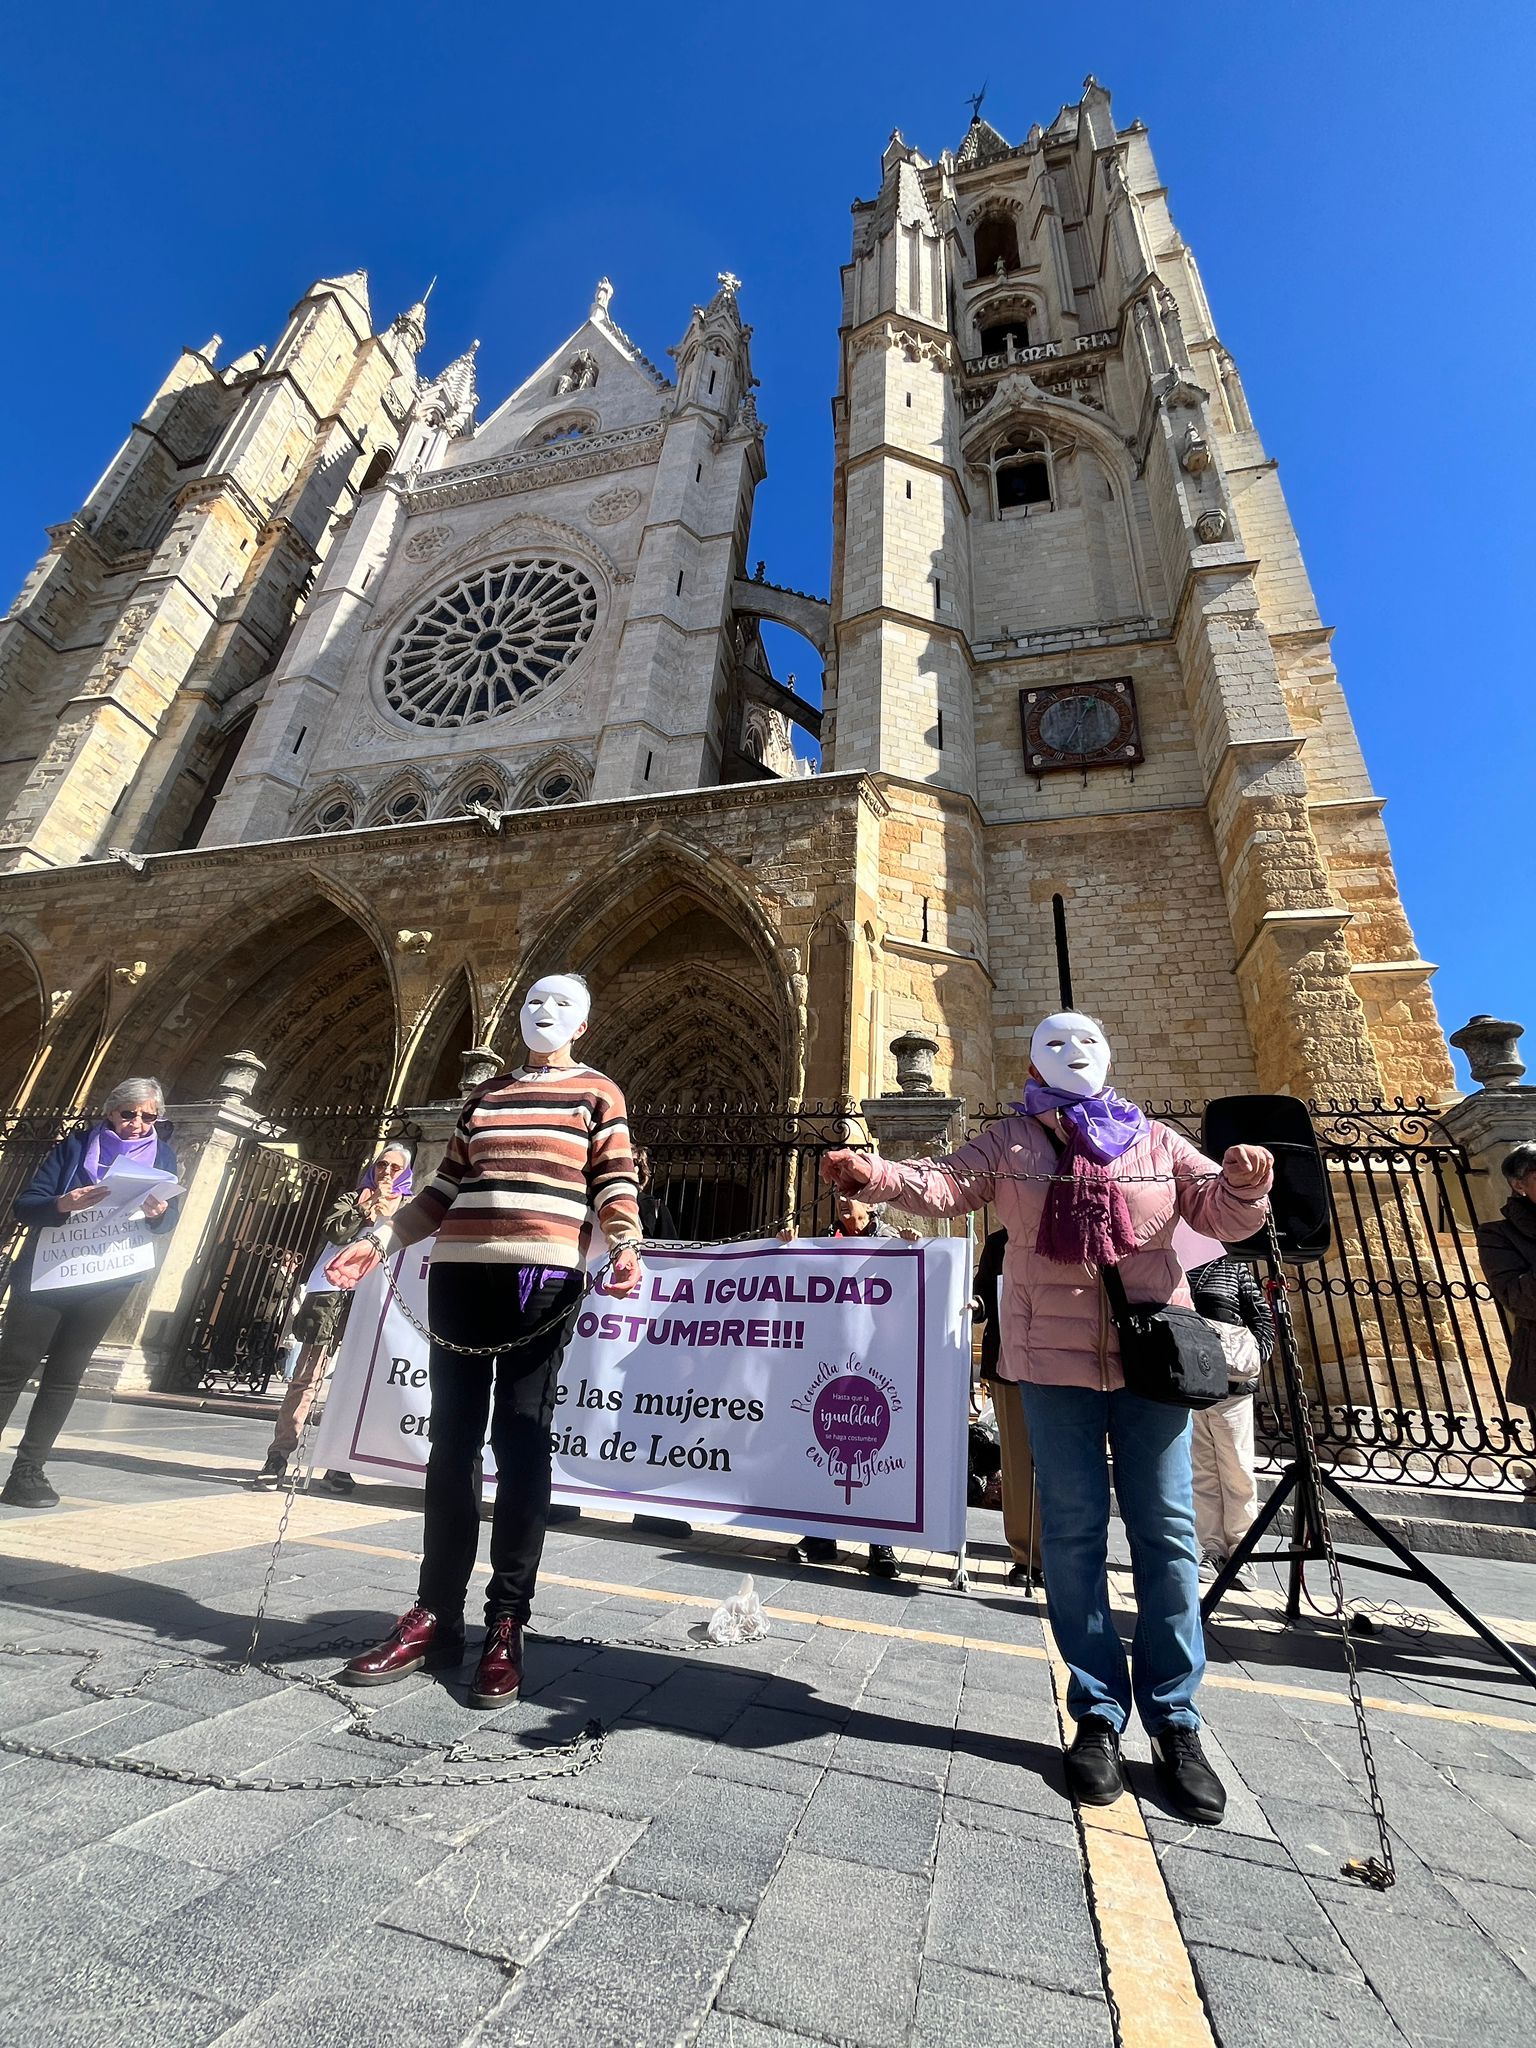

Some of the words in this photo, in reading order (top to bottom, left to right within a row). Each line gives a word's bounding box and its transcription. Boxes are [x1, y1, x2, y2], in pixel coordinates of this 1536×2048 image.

[51, 1231, 66, 1244] LA
[70, 1224, 120, 1241] IGLESIA
[121, 1220, 140, 1232] SEA
[42, 1249, 68, 1263] UNA
[71, 1235, 145, 1259] COMUNIDAD
[60, 1264, 78, 1278] DE
[82, 1253, 136, 1275] IGUALES
[651, 1276, 695, 1304] LA
[703, 1274, 894, 1306] IGUALDAD
[576, 1311, 805, 1350] OSTUMBRE!!!
[790, 1361, 840, 1413] Revuelta
[846, 1351, 862, 1373] de
[868, 1367, 904, 1414] mujeres
[575, 1378, 624, 1412] las
[633, 1388, 765, 1424] mujeres
[832, 1393, 850, 1401] Hasta
[851, 1395, 863, 1403] que
[863, 1394, 870, 1402] la
[820, 1403, 883, 1432] igualdad
[599, 1431, 638, 1463] de
[646, 1433, 732, 1472] León
[832, 1433, 847, 1442] haga
[847, 1434, 878, 1443] costumbre
[805, 1446, 826, 1468] en
[827, 1445, 848, 1477] la
[853, 1448, 907, 1487] Iglesia
